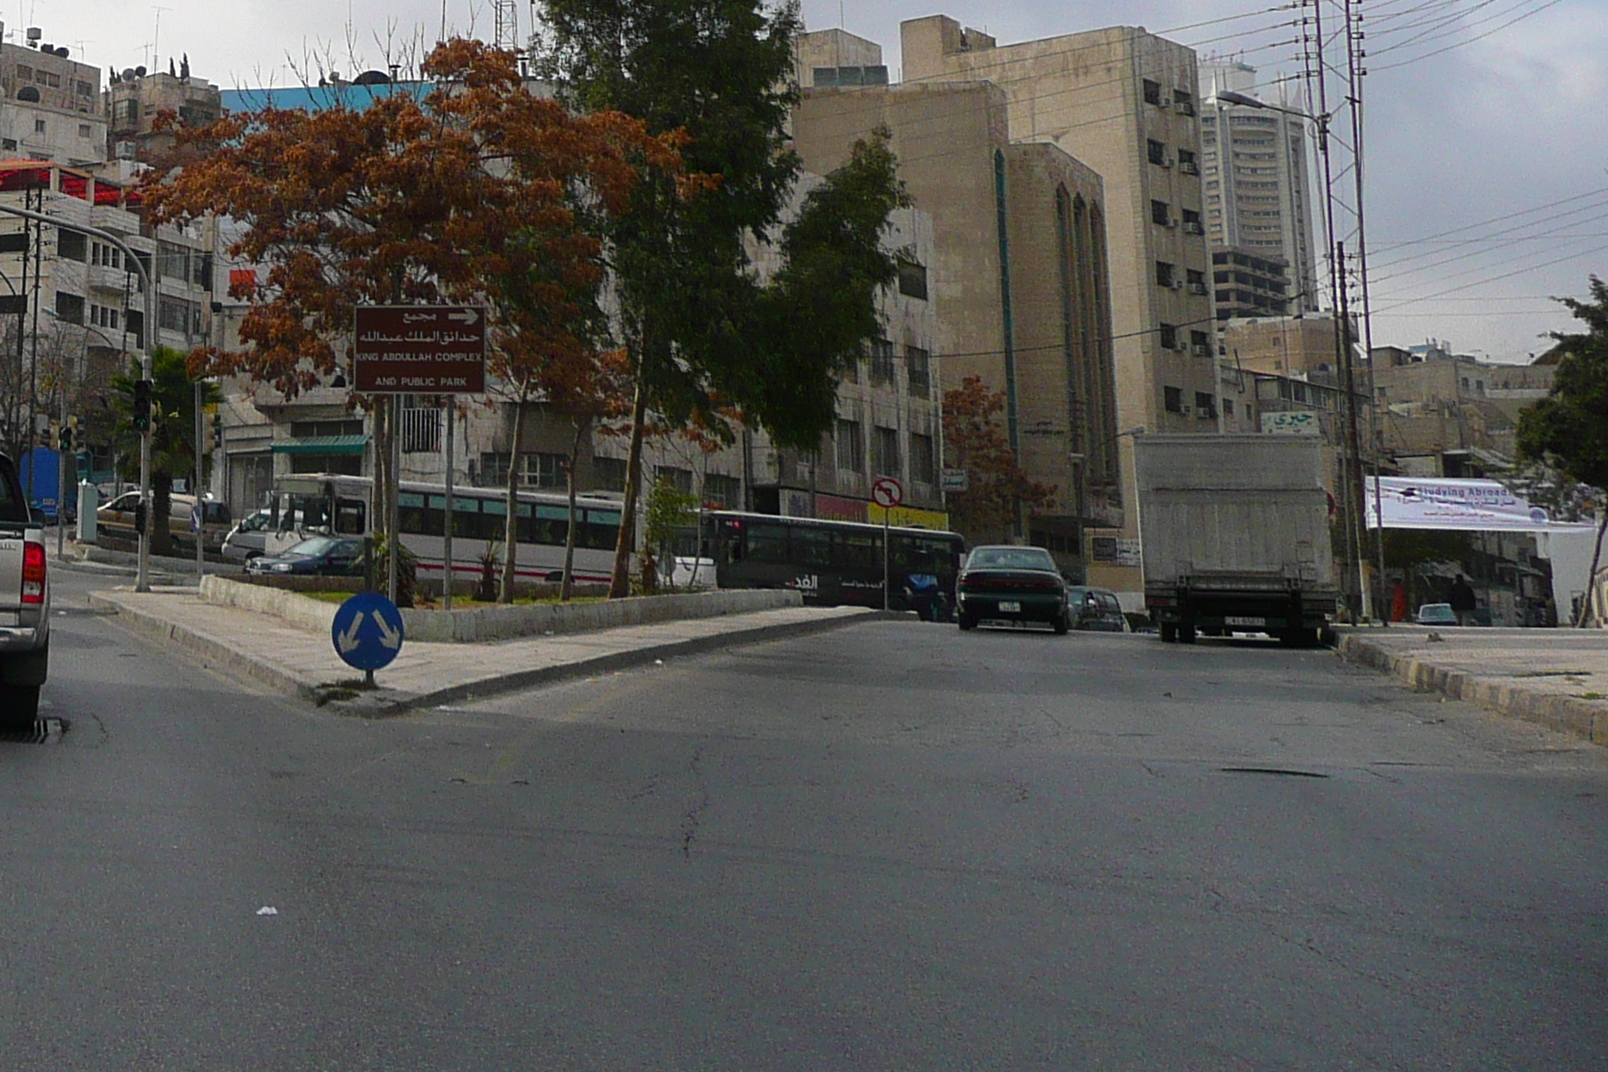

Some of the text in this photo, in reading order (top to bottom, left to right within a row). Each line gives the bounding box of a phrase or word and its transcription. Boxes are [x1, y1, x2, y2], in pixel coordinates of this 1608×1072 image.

[402, 312, 437, 324] مجمع
[404, 330, 440, 343] الملك
[440, 330, 480, 345] حدائق
[356, 352, 482, 362] KING ABDULLAH COMPLEX
[375, 377, 467, 386] AND PUBLIC PARK
